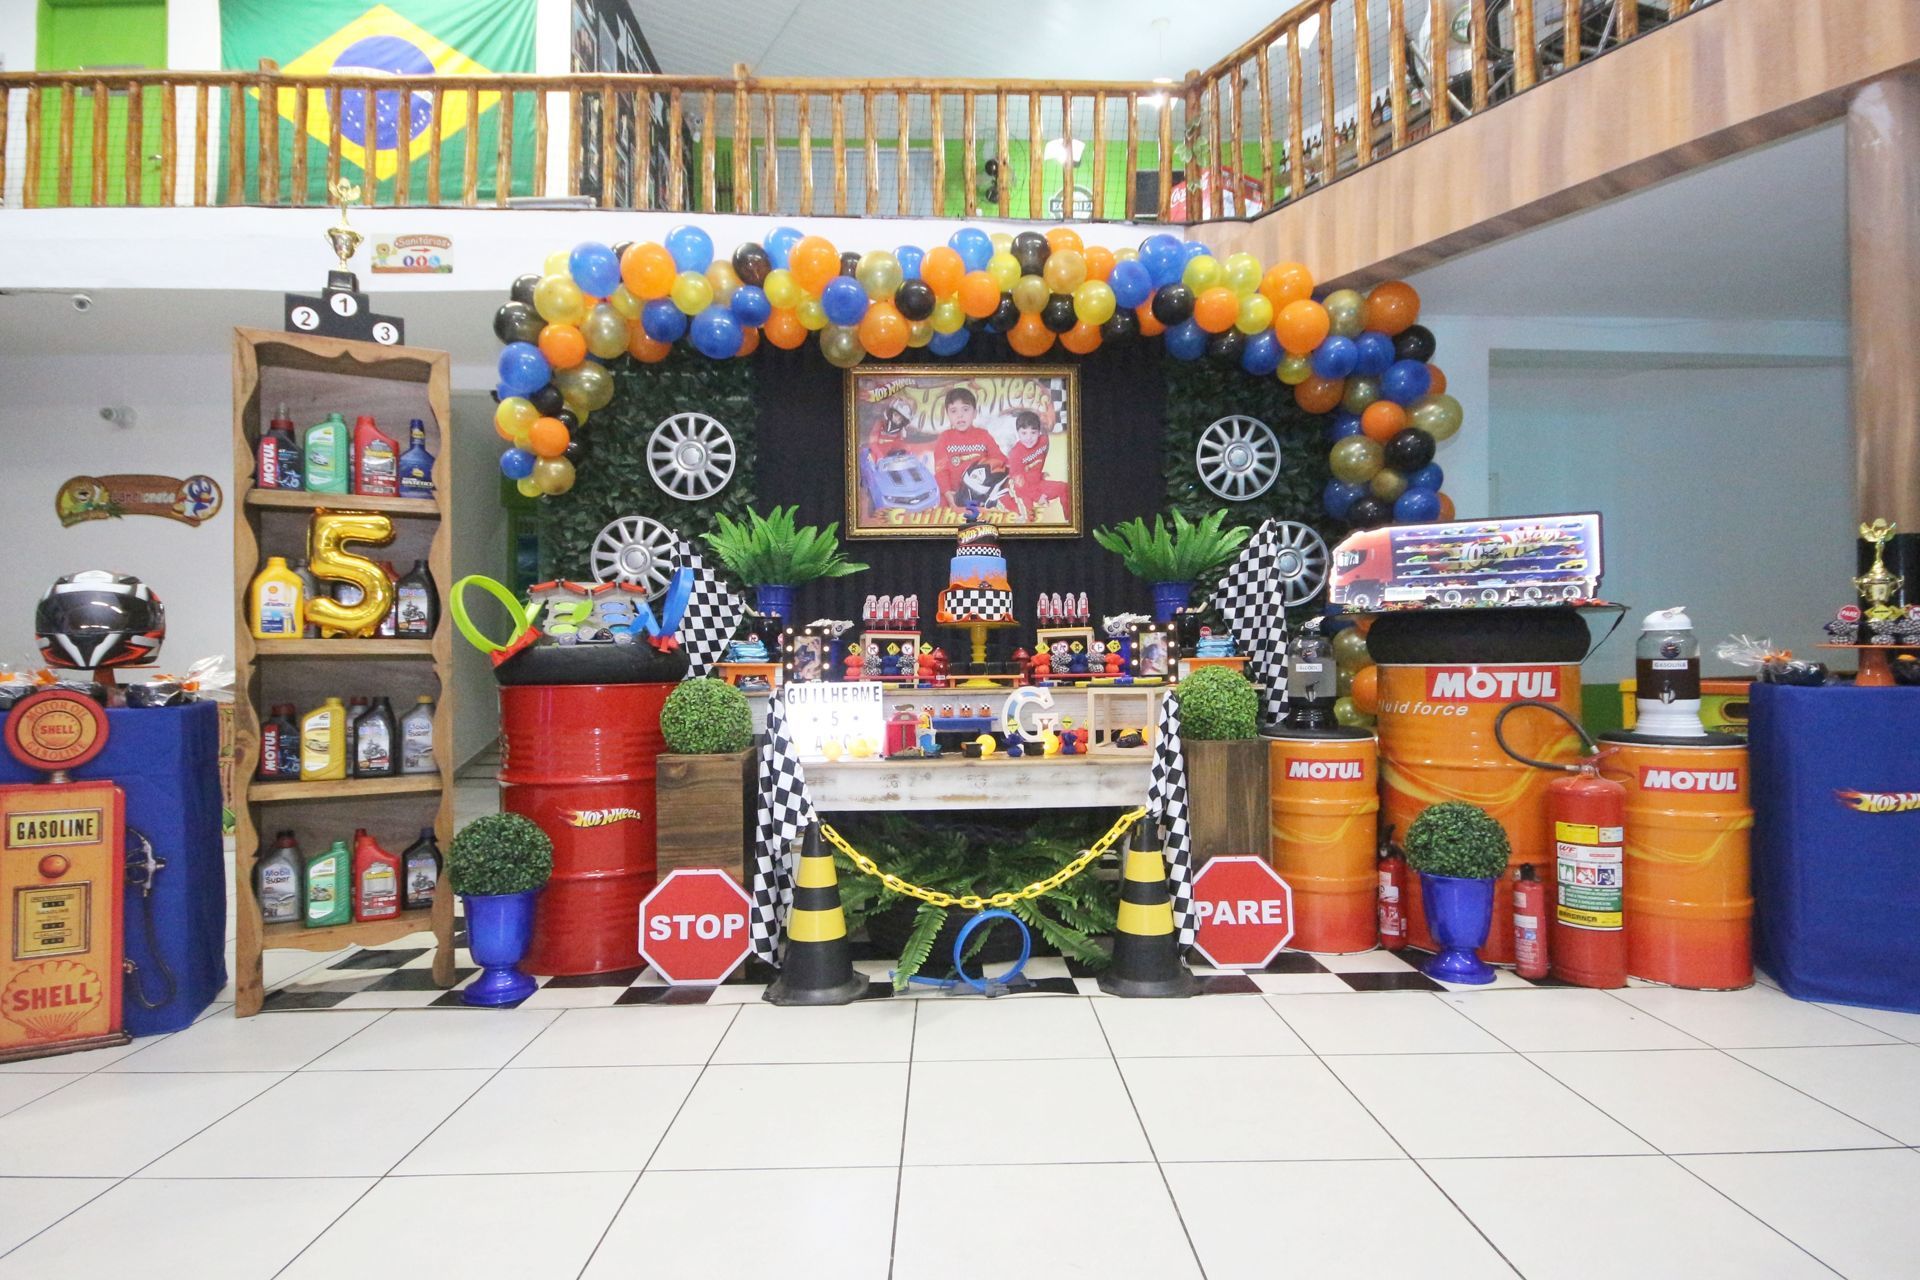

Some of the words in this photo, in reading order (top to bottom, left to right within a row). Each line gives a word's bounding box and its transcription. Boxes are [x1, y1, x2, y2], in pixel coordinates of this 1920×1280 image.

[339, 297, 348, 313] 1
[300, 310, 312, 326] 2
[380, 326, 391, 341] 3
[263, 443, 276, 484] MOTUL
[306, 508, 396, 638] 5
[787, 686, 880, 704] GUILHERME
[1431, 671, 1557, 699] MOTUL
[1001, 685, 1059, 743] G
[1412, 701, 1469, 716] force
[40, 724, 75, 735] SHELL
[26, 739, 86, 761] GASOLINE
[264, 731, 276, 771] MOTUL
[1288, 761, 1362, 779] MOTUL
[1643, 769, 1738, 791] MOTUL
[16, 817, 94, 841] GASOLINE
[575, 810, 604, 827] HOT
[1194, 900, 1283, 926] PARE
[649, 913, 745, 941] STOP
[12, 982, 94, 1012] SHELL
